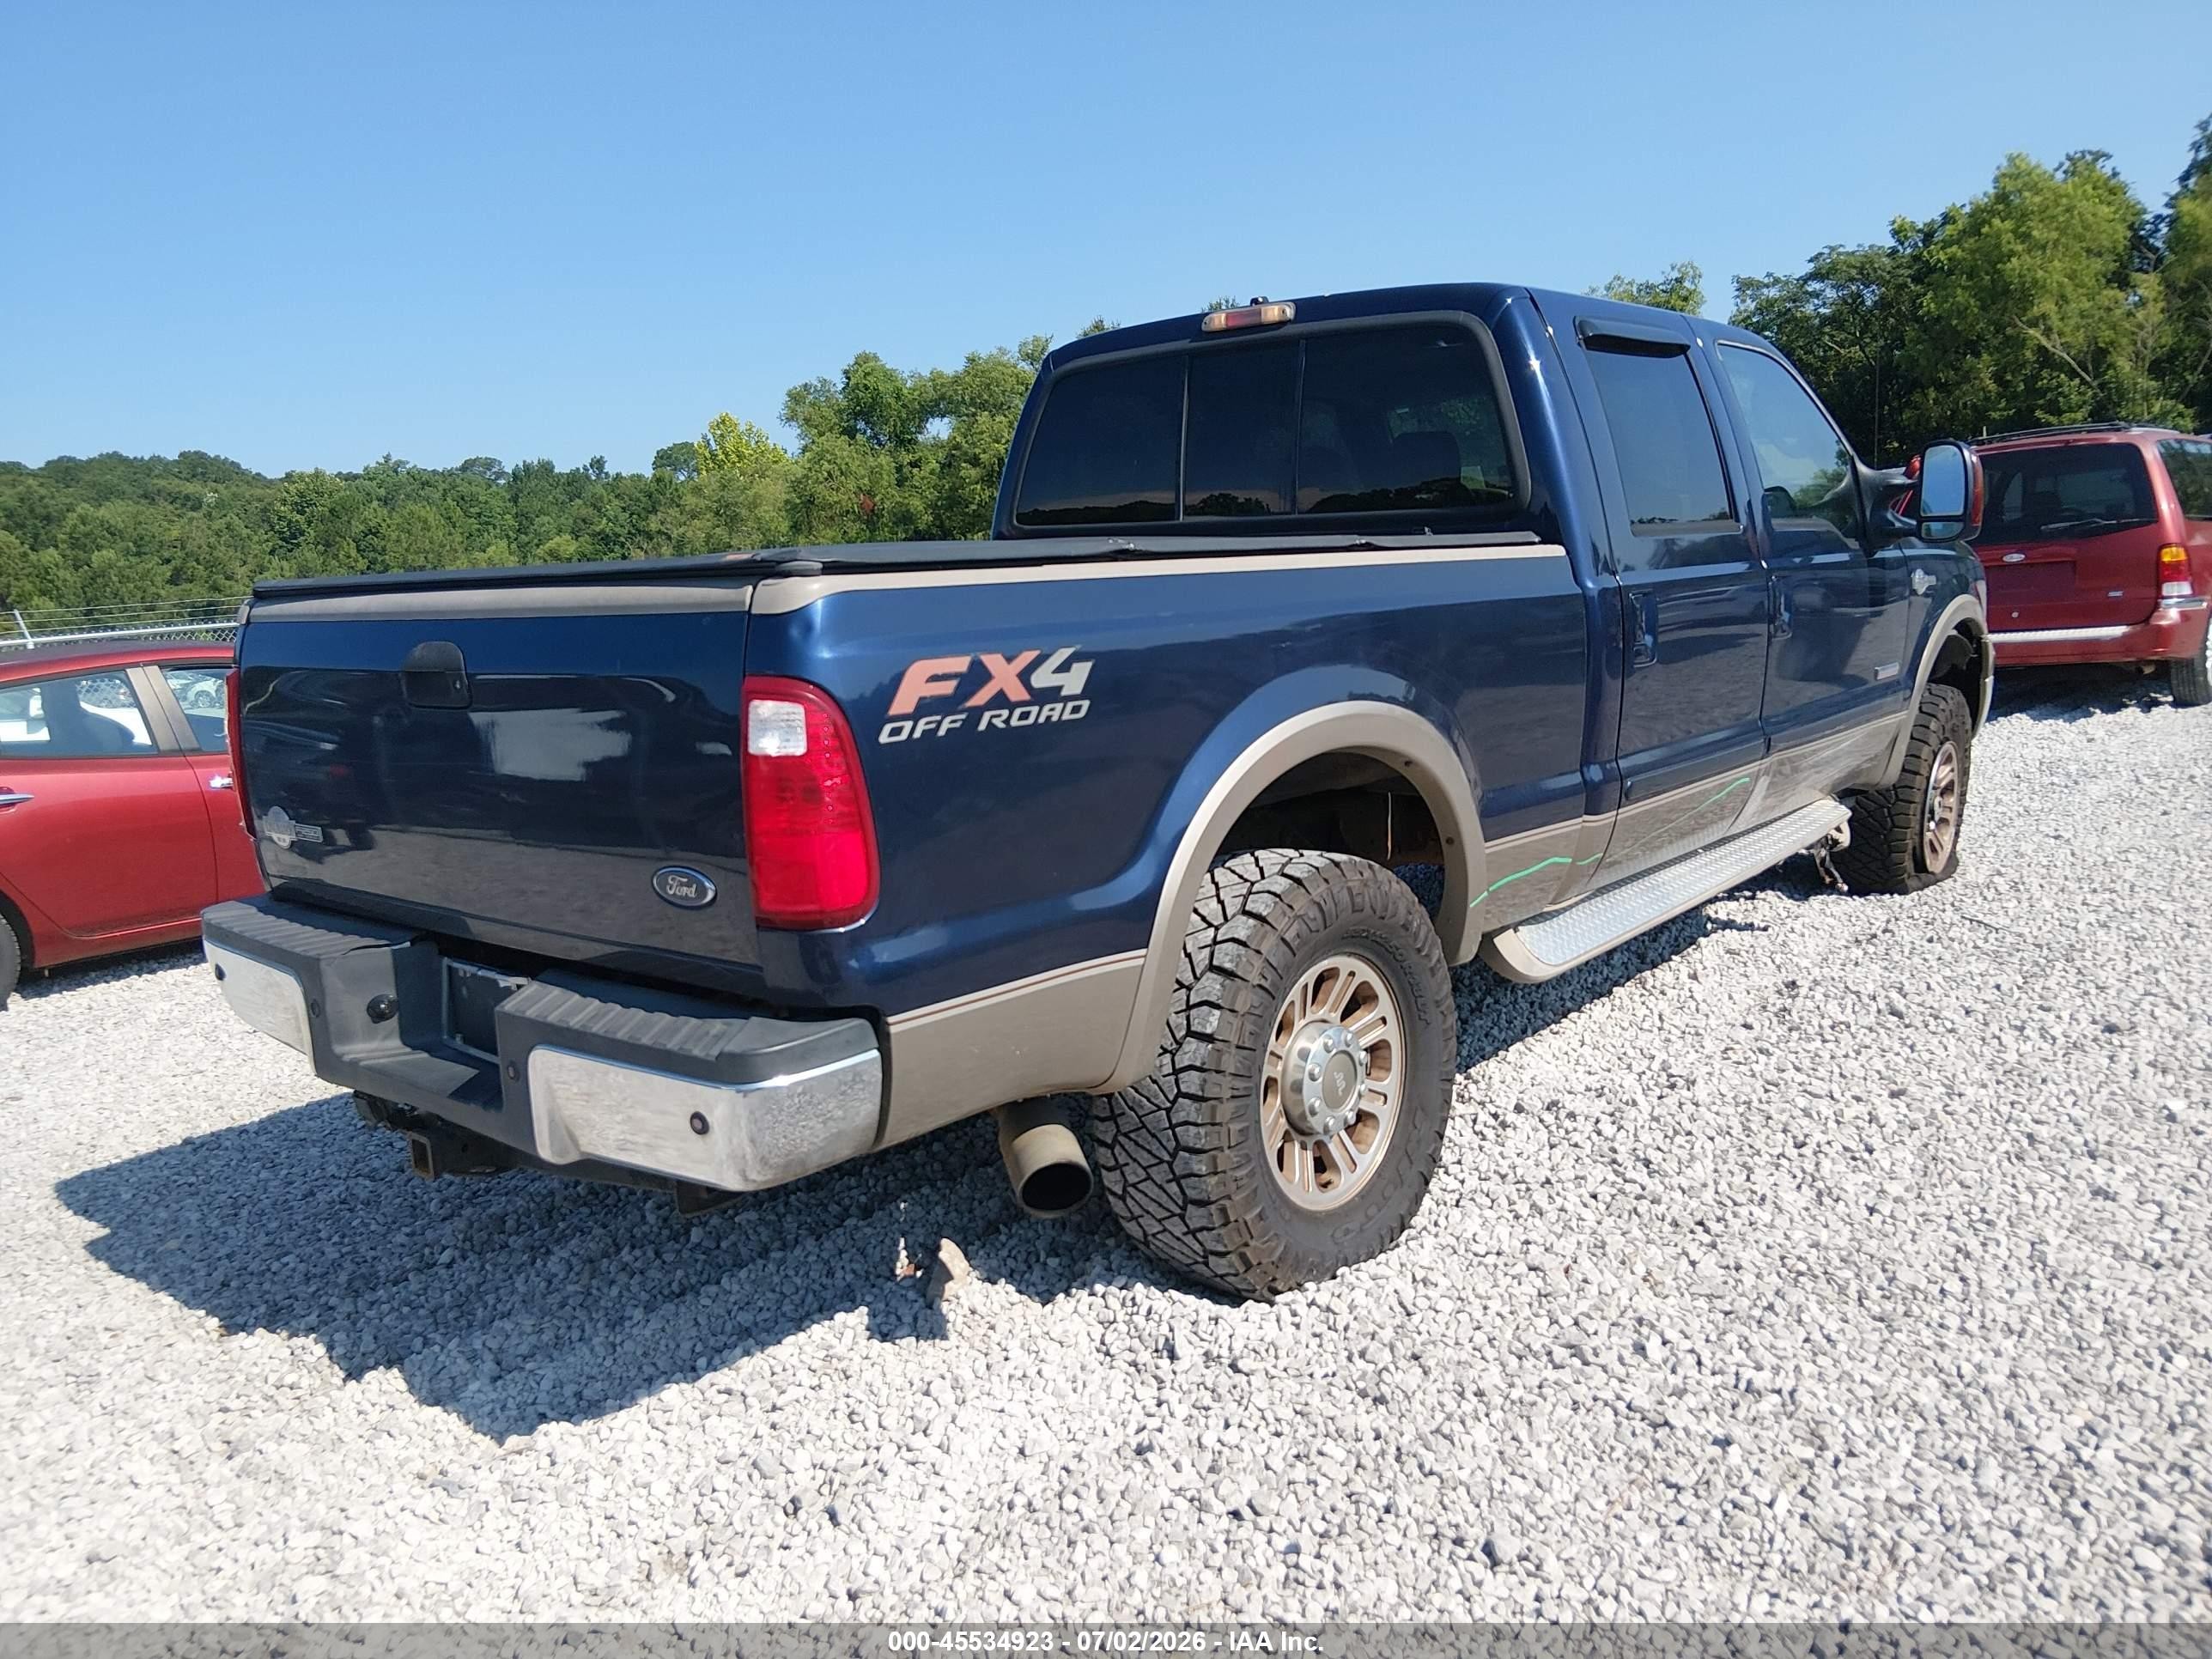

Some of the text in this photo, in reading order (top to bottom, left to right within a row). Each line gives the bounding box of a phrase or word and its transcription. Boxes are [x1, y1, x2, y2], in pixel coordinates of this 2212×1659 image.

[886, 645, 1095, 716] FX4
[878, 699, 1091, 744] OFF ROAD
[665, 874, 697, 898] Ford
